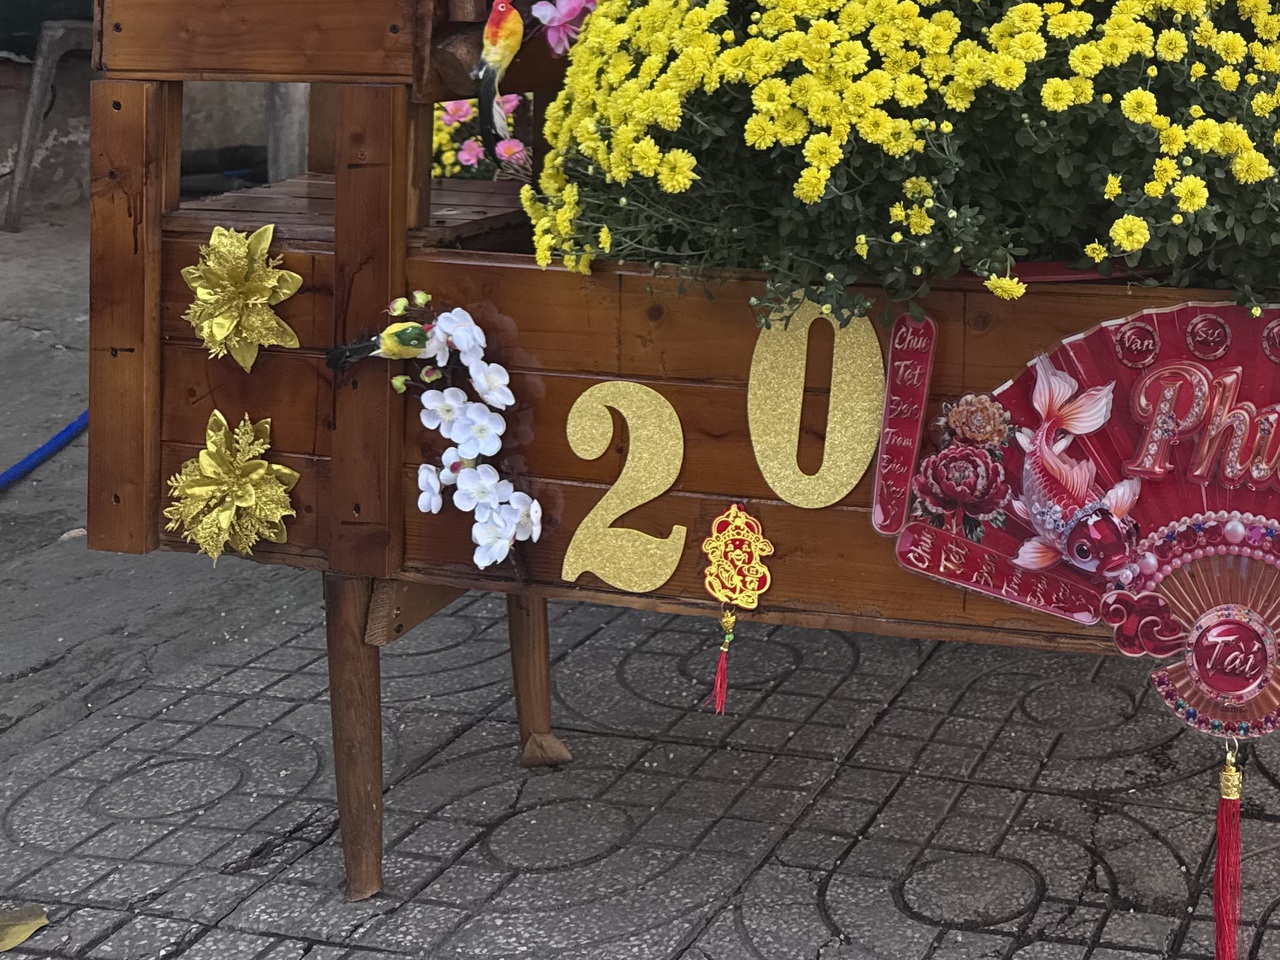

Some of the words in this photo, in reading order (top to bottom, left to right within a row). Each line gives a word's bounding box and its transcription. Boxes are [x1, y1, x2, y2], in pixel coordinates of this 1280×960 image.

[895, 325, 930, 352] Chúc
[1123, 336, 1155, 355] Vạn
[907, 528, 937, 568] Chúc
[1203, 633, 1263, 679] Tài
